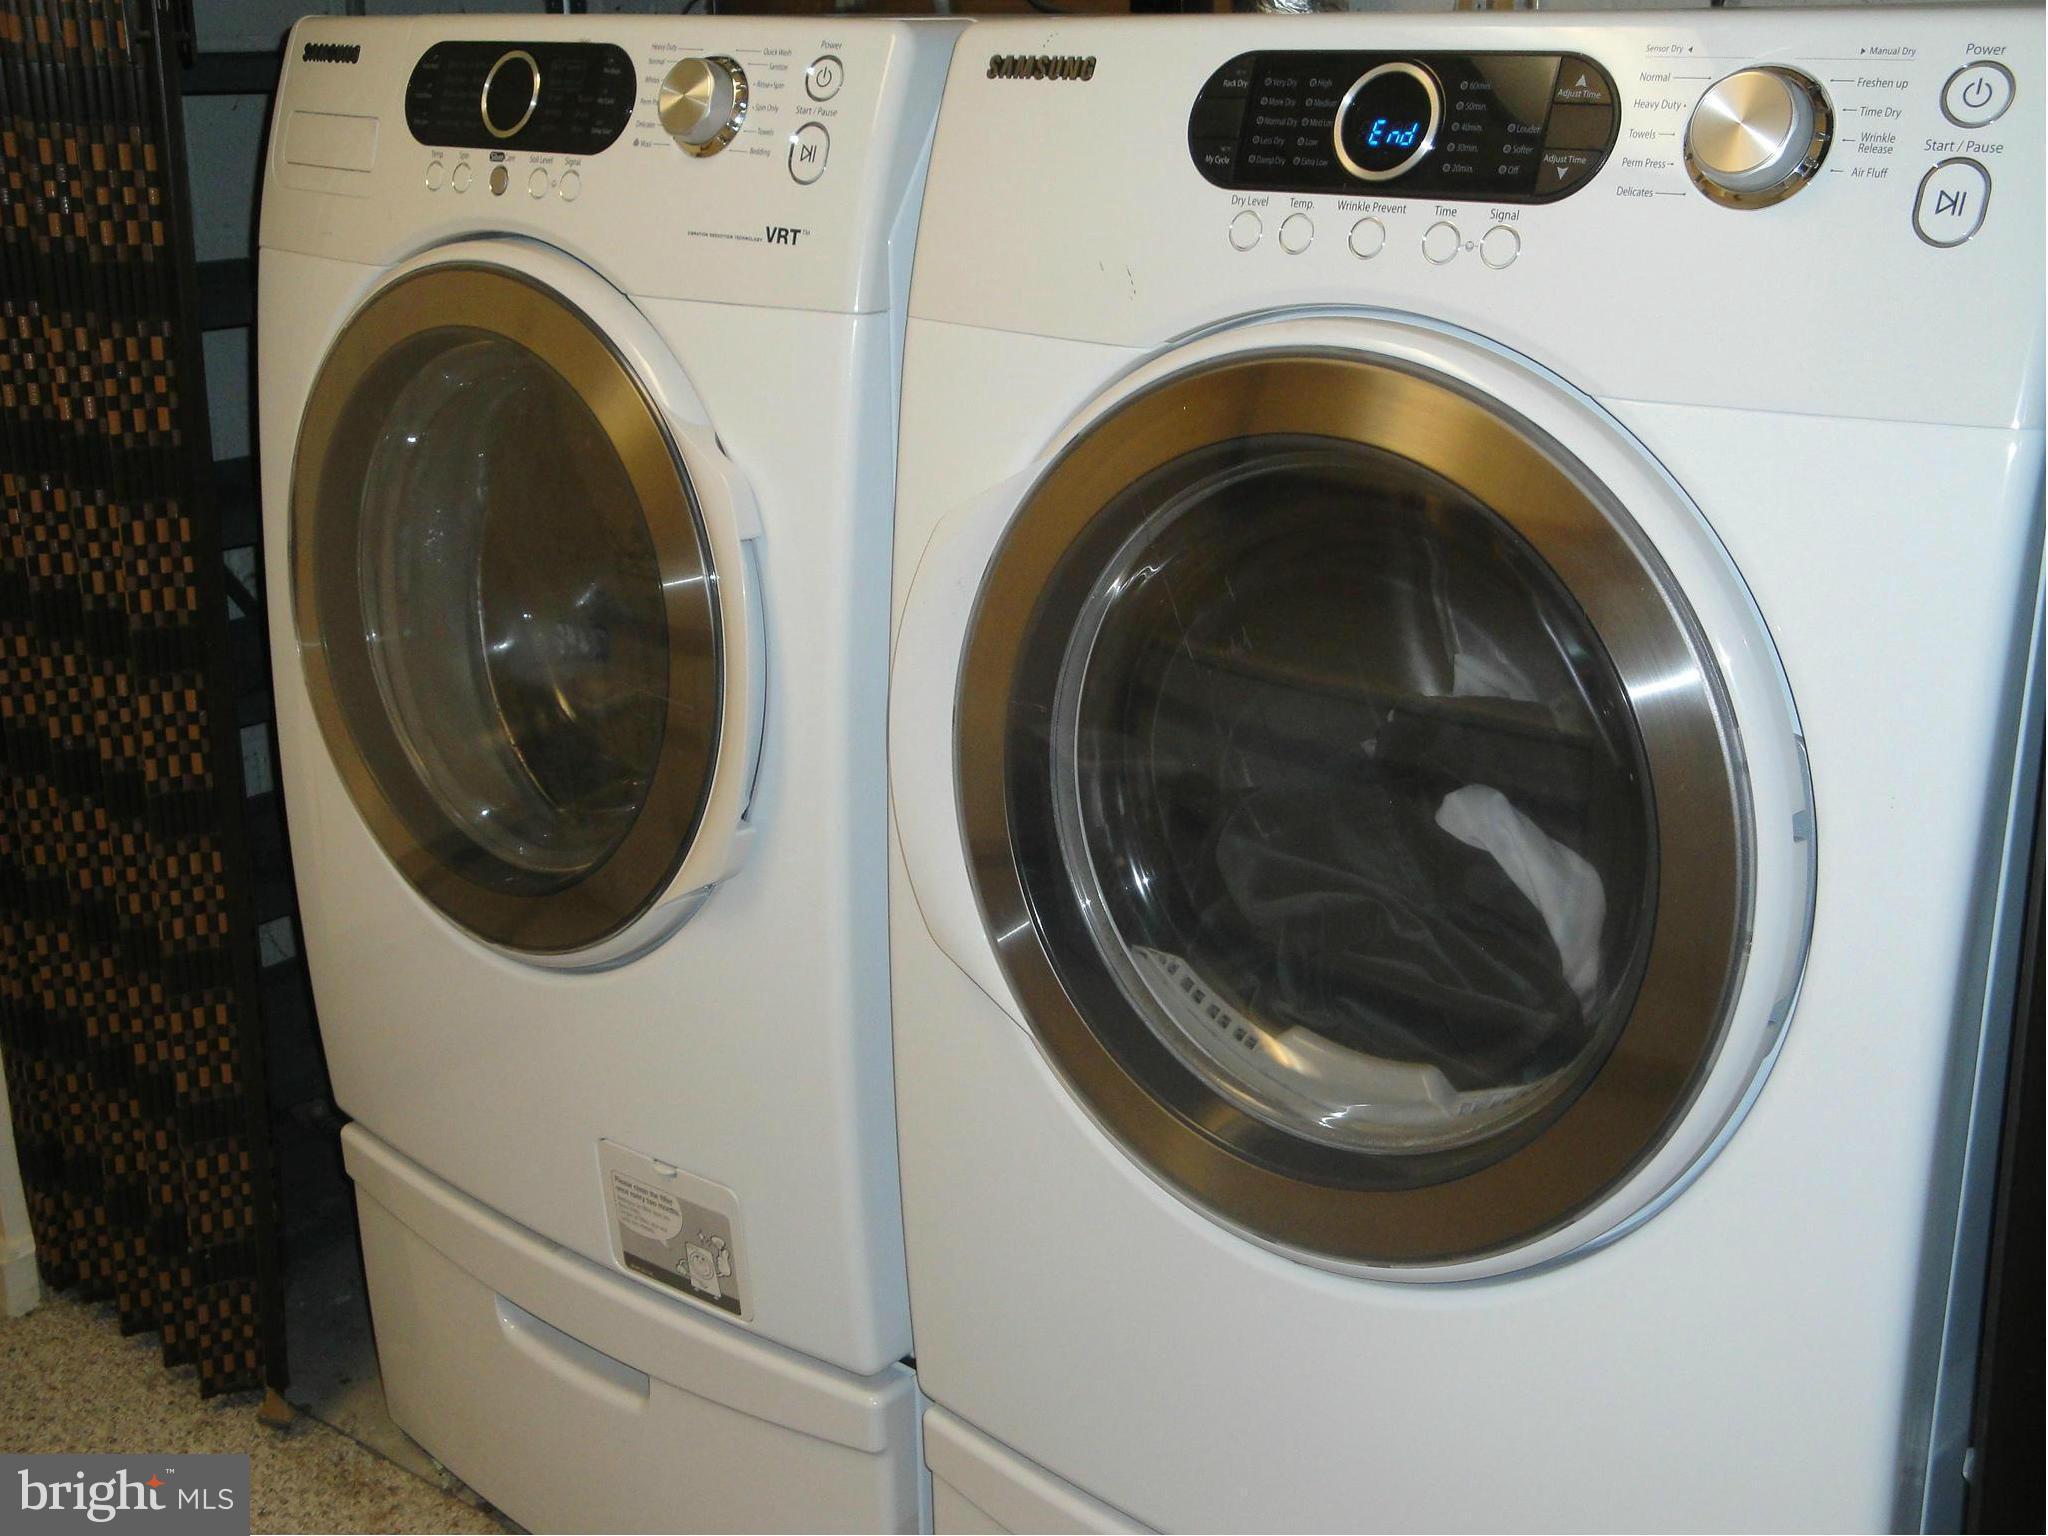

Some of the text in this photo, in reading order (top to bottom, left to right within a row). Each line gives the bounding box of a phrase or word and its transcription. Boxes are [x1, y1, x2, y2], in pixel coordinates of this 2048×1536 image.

[820, 41, 842, 50] Power
[1646, 44, 1684, 54] Sensor Dry
[1966, 43, 2007, 56] Power
[302, 42, 361, 64] SAMSUNG
[1869, 46, 1917, 58] Manual Dry
[986, 54, 1097, 82] SAMSUNG
[1639, 72, 1671, 82] Normal
[1238, 80, 1249, 89] Dry
[1287, 80, 1298, 88] Dry
[1856, 77, 1909, 90] Freshen up
[1558, 88, 1602, 99] Adjust Time
[1633, 98, 1682, 112] Heavy Duty
[796, 106, 812, 116] Start
[817, 107, 838, 117] Pause
[1860, 106, 1903, 120] Time Dry
[1367, 119, 1418, 146] End
[1516, 124, 1541, 134] Louder
[1629, 128, 1656, 140] Towels
[1860, 132, 1896, 144] Wrinkle
[1858, 142, 1894, 155] Release
[1924, 138, 1955, 152] Start
[1966, 140, 2004, 154] Pause
[1544, 153, 1587, 164] Adjust Time
[1622, 157, 1666, 169] Perm Press
[1850, 167, 1889, 179] Air Fluff
[1616, 186, 1654, 198] Delicates
[1231, 194, 1270, 208] Dry Level
[1290, 197, 1315, 210] Temp.
[1337, 199, 1407, 214] Wrinkle Prevent
[1434, 205, 1458, 218] Time
[1490, 208, 1520, 223] Signal
[766, 226, 802, 246] VRT
